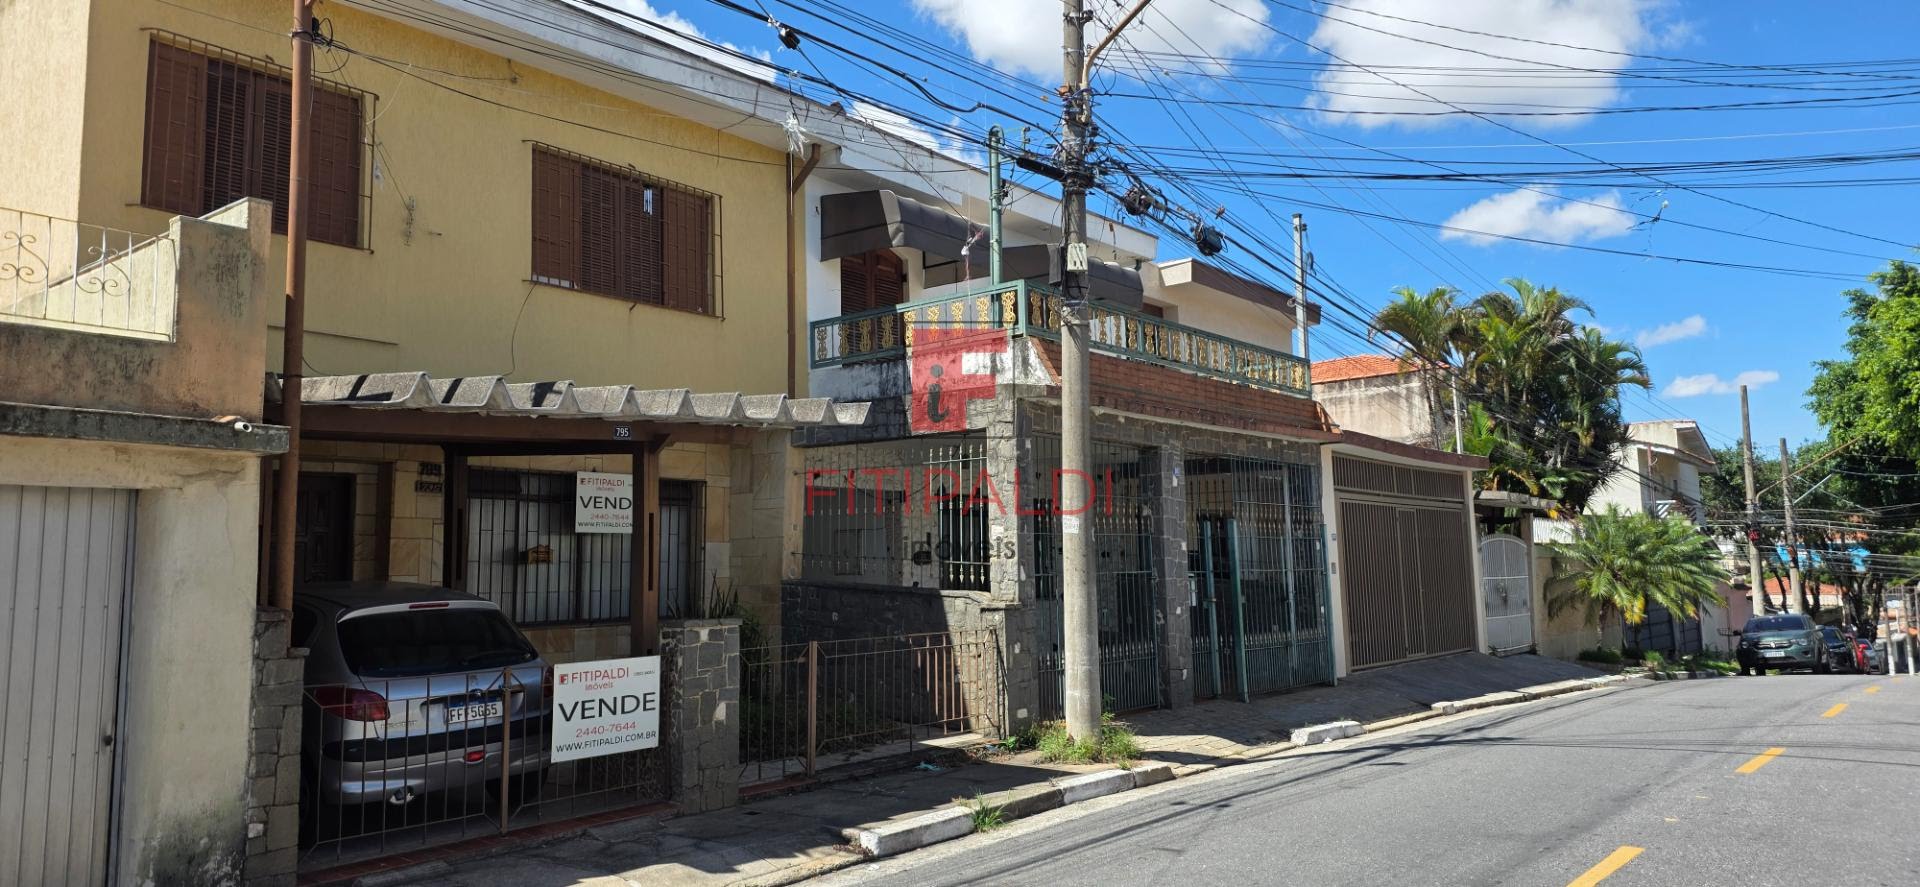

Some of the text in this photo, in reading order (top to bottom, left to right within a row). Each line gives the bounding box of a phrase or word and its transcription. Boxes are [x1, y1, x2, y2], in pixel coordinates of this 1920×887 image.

[616, 427, 629, 437] 795
[579, 495, 632, 510] VEND
[571, 667, 630, 684] FITIPALDI
[558, 691, 657, 722] VENDE
[575, 721, 636, 738] 2440-7644
[556, 730, 657, 753] WWW.FITIPALDI.COM.BR
